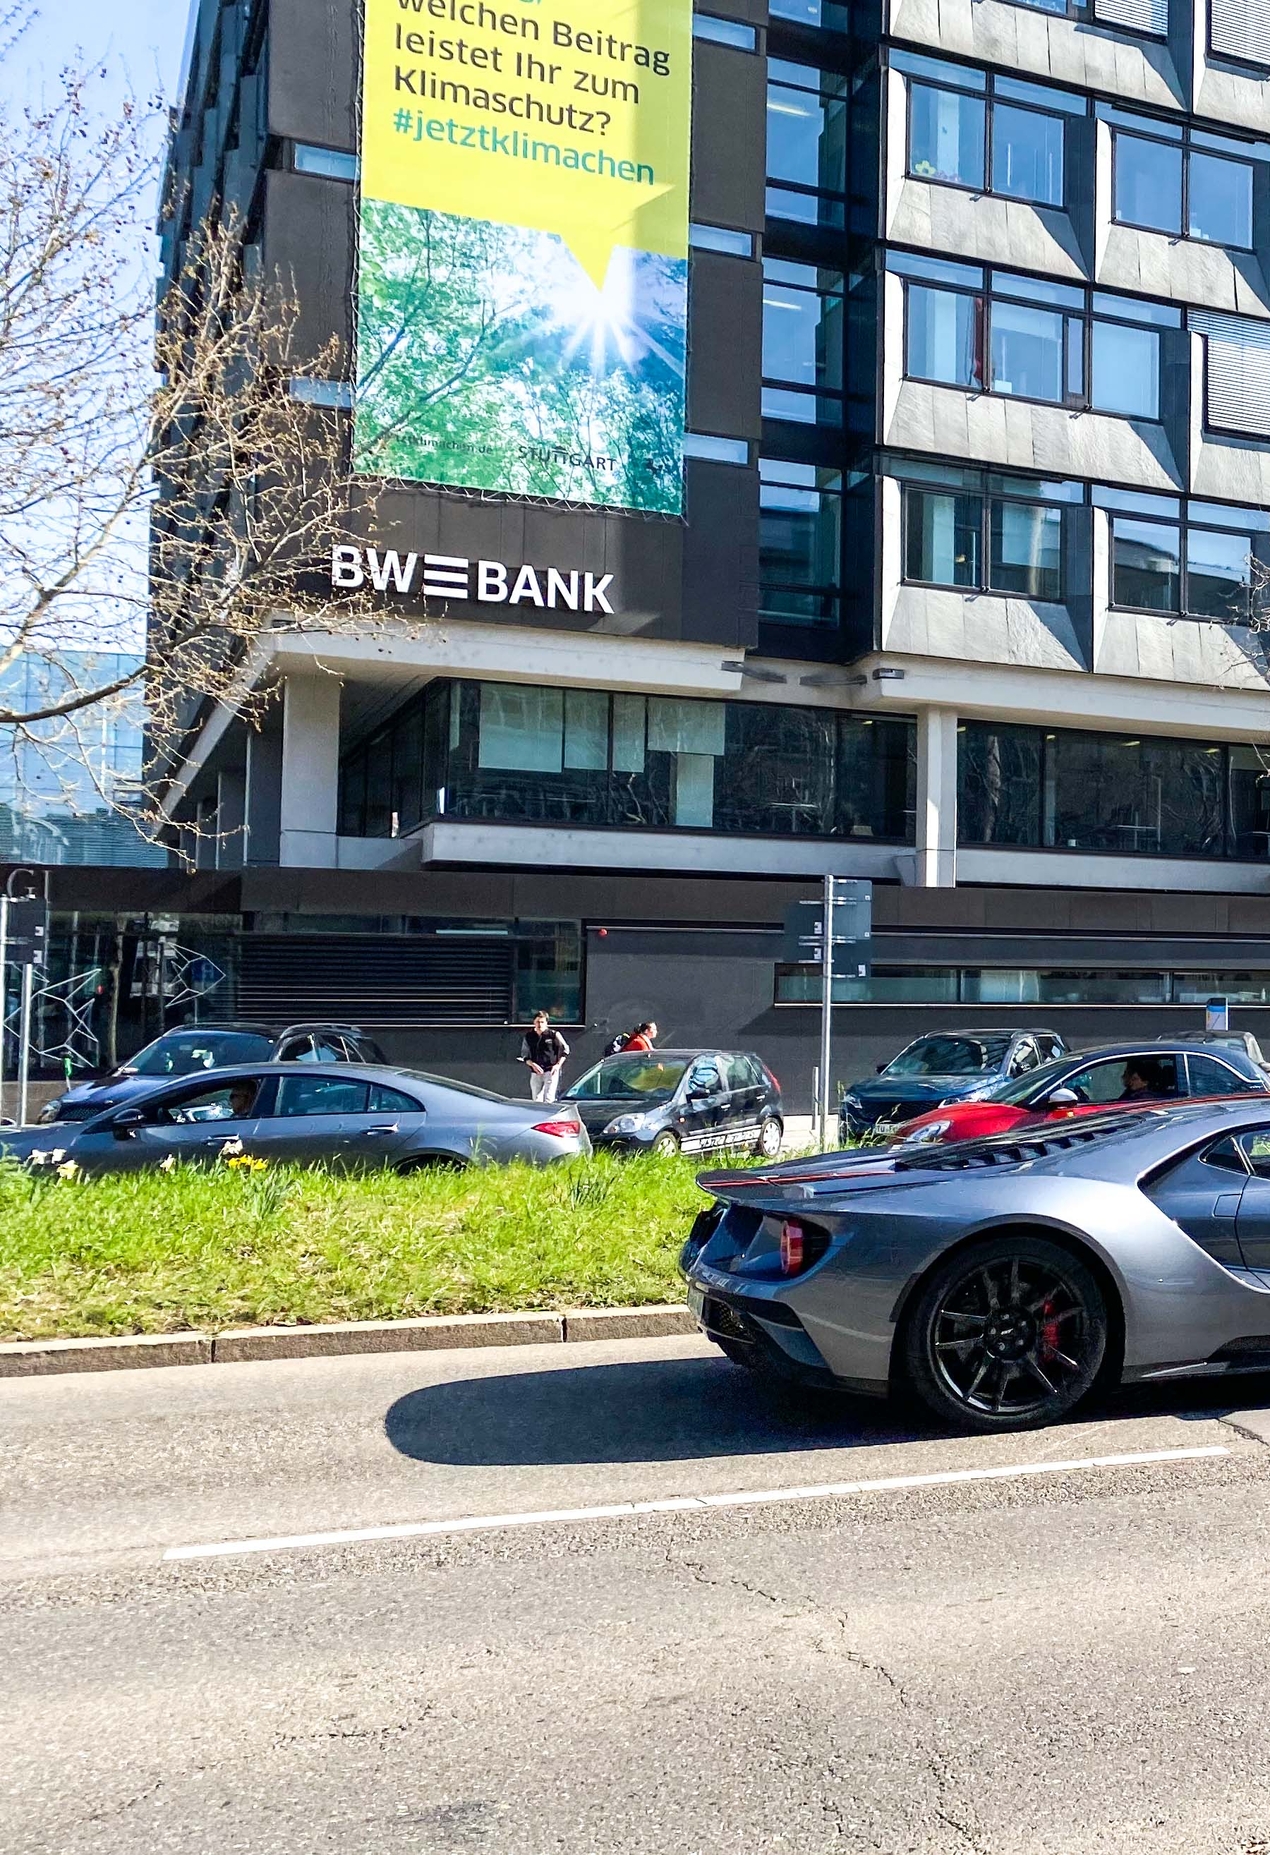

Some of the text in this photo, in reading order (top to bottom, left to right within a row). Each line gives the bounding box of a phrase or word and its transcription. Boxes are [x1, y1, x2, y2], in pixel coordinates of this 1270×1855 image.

[395, 23, 640, 104] leistet Ihr zum
[552, 20, 671, 77] Beitrag
[393, 65, 612, 137] Klimaschutz?
[392, 107, 655, 186] #jetztklimachen
[477, 559, 615, 614] BANK
